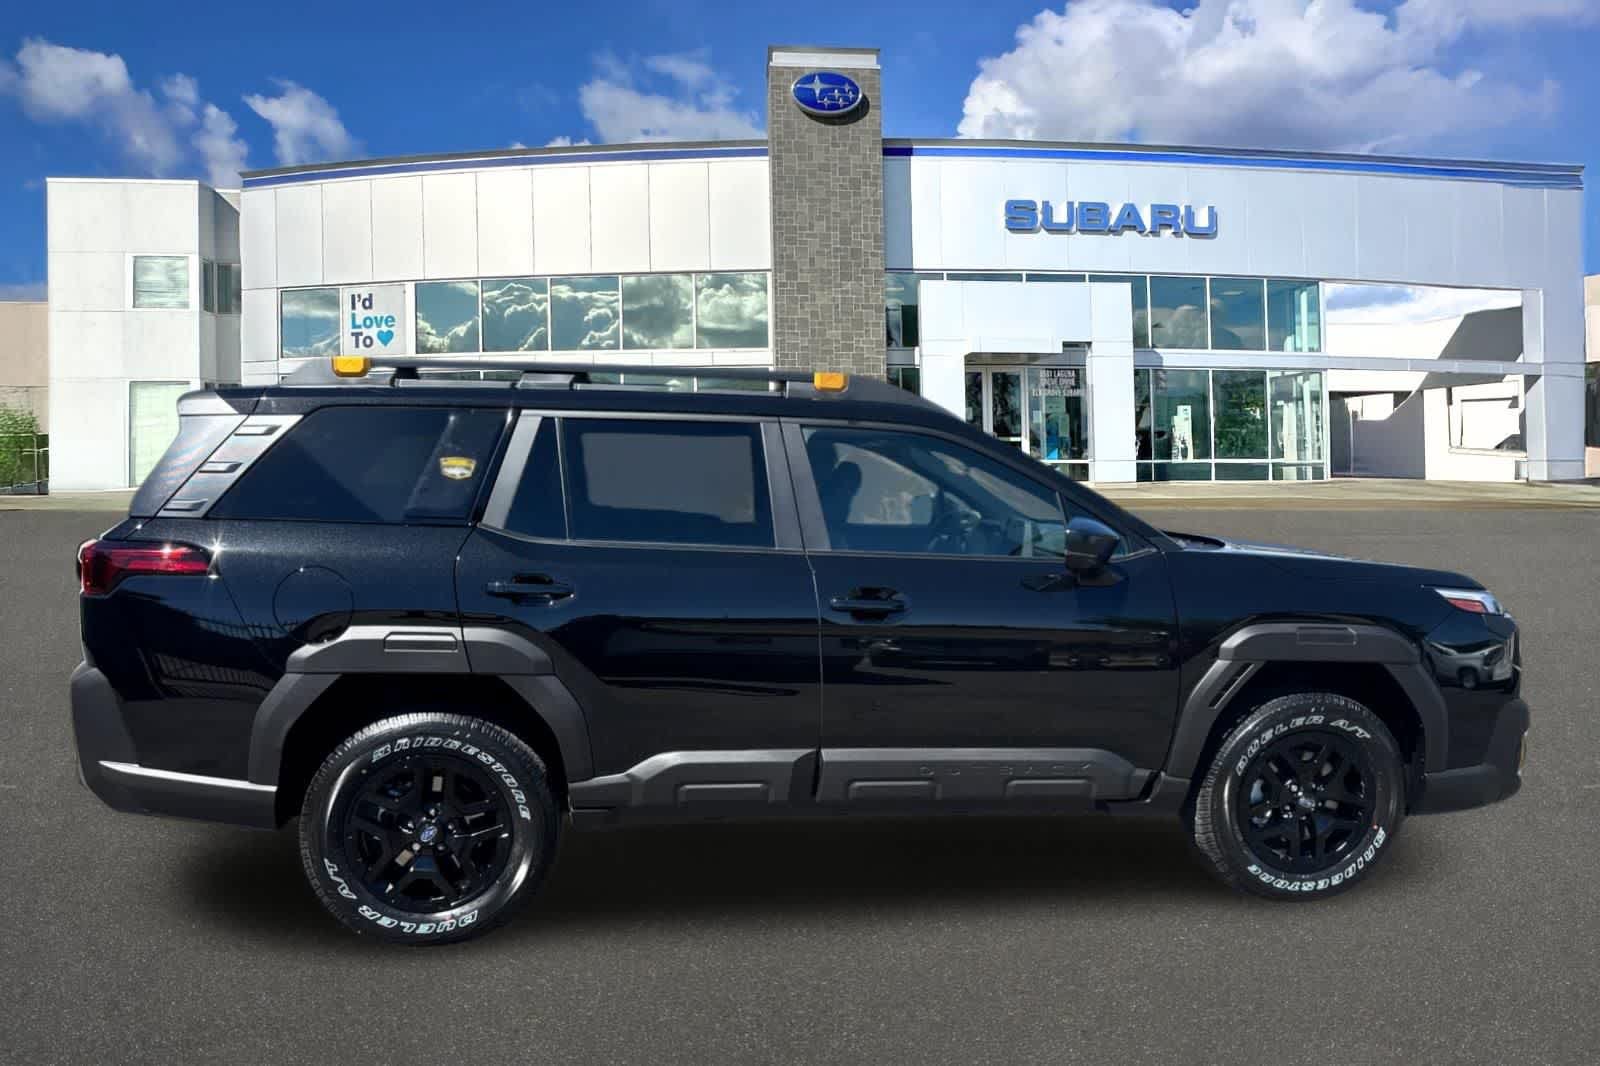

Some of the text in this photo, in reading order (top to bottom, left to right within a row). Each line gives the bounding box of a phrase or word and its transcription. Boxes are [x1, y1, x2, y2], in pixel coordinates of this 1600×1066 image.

[1005, 199, 1217, 238] SUBARU
[351, 293, 373, 310] I'd
[351, 312, 396, 329] Love
[351, 331, 374, 349] To
[1236, 715, 1324, 776] DUELER
[372, 737, 532, 821] BRIDGESTONE
[1248, 826, 1387, 891] BRIDGESTONE
[358, 904, 479, 934] DUELER
